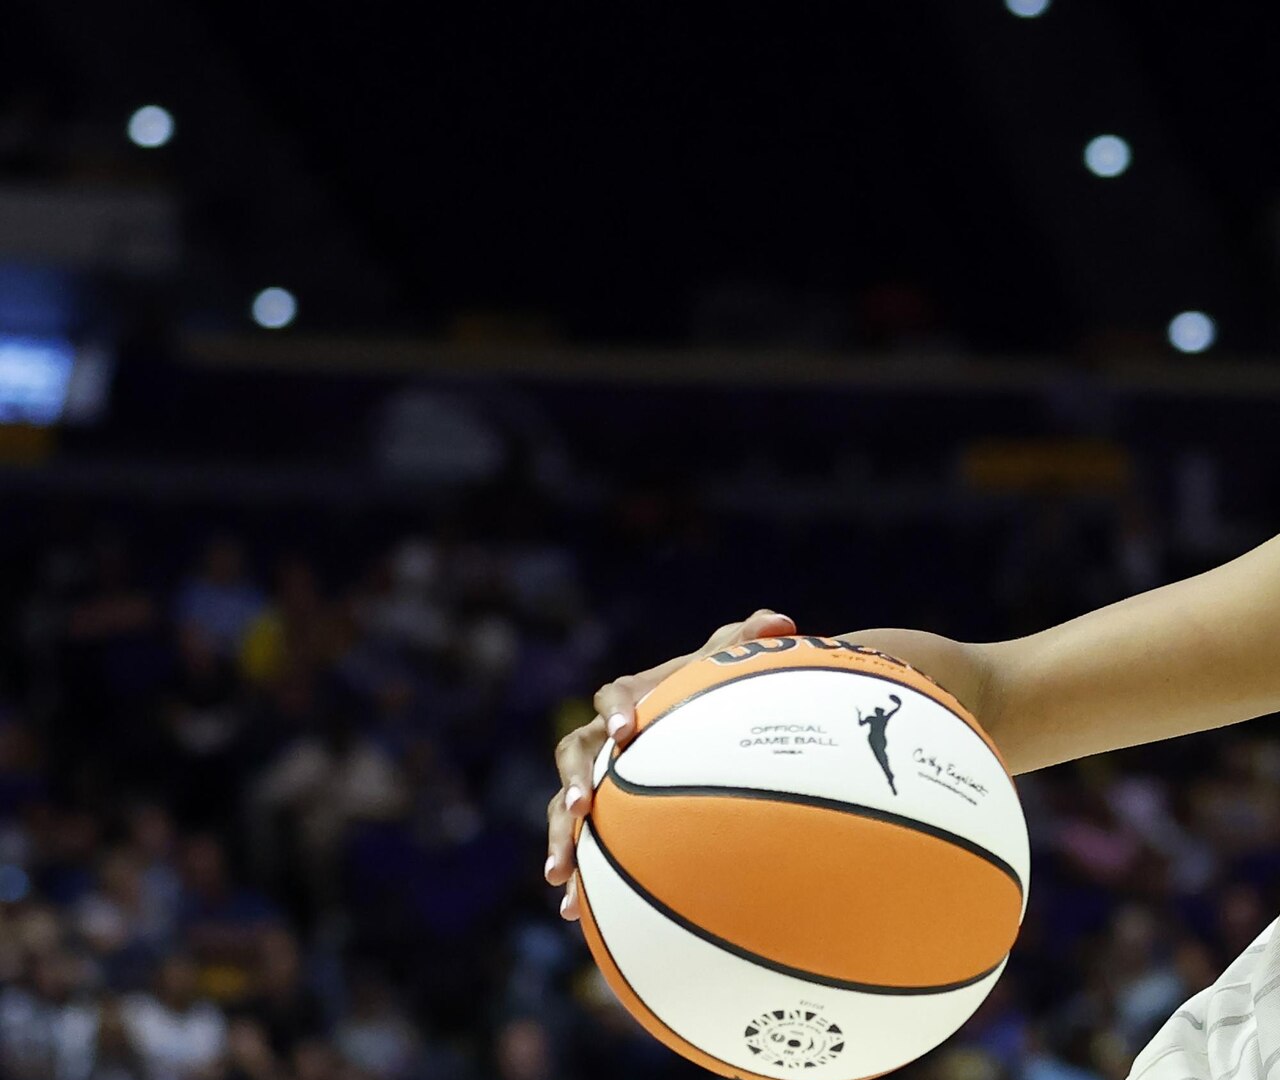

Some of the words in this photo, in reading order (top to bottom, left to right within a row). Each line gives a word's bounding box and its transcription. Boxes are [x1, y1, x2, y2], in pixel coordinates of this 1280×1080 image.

[751, 724, 828, 735] OFFICIAL
[740, 736, 790, 748] GAME
[794, 736, 839, 747] BALL
